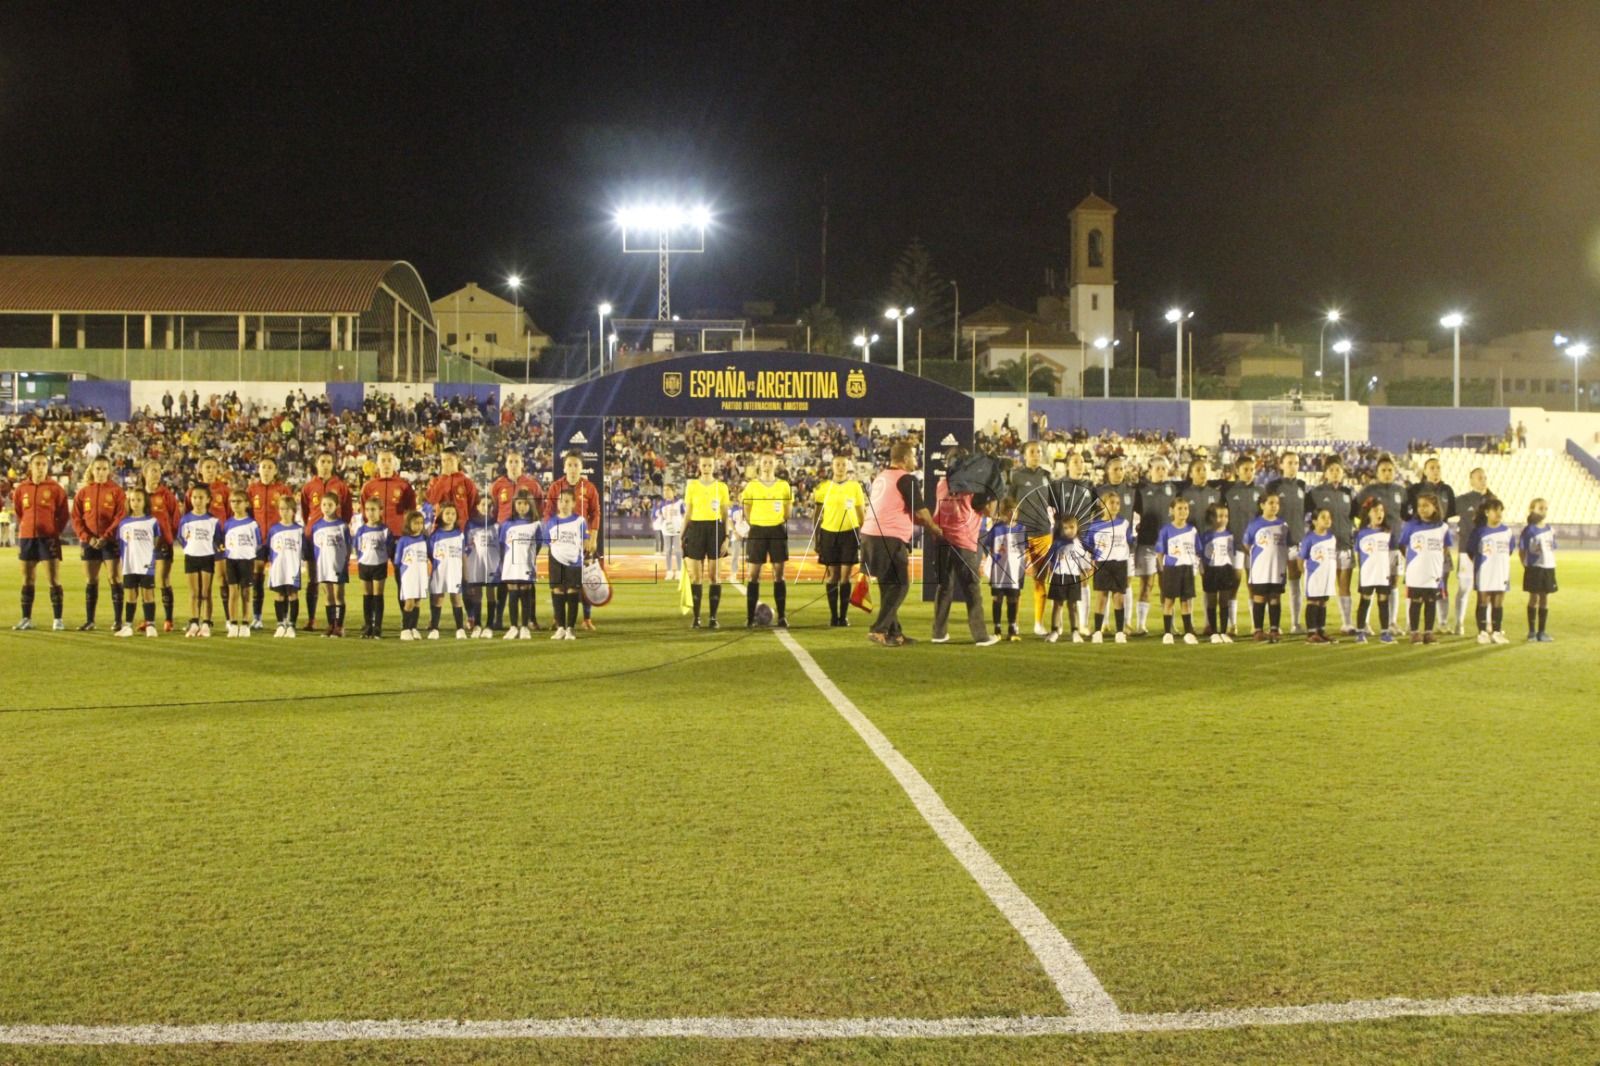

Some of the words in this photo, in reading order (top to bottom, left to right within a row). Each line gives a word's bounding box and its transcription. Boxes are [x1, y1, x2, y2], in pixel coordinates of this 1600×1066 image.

[690, 366, 746, 398] ESPAÑA
[756, 370, 839, 399] ARGENTINA
[721, 401, 742, 411] PARTIDO
[743, 401, 782, 411] INTERNACIONAL
[783, 402, 809, 411] AMISTOSO
